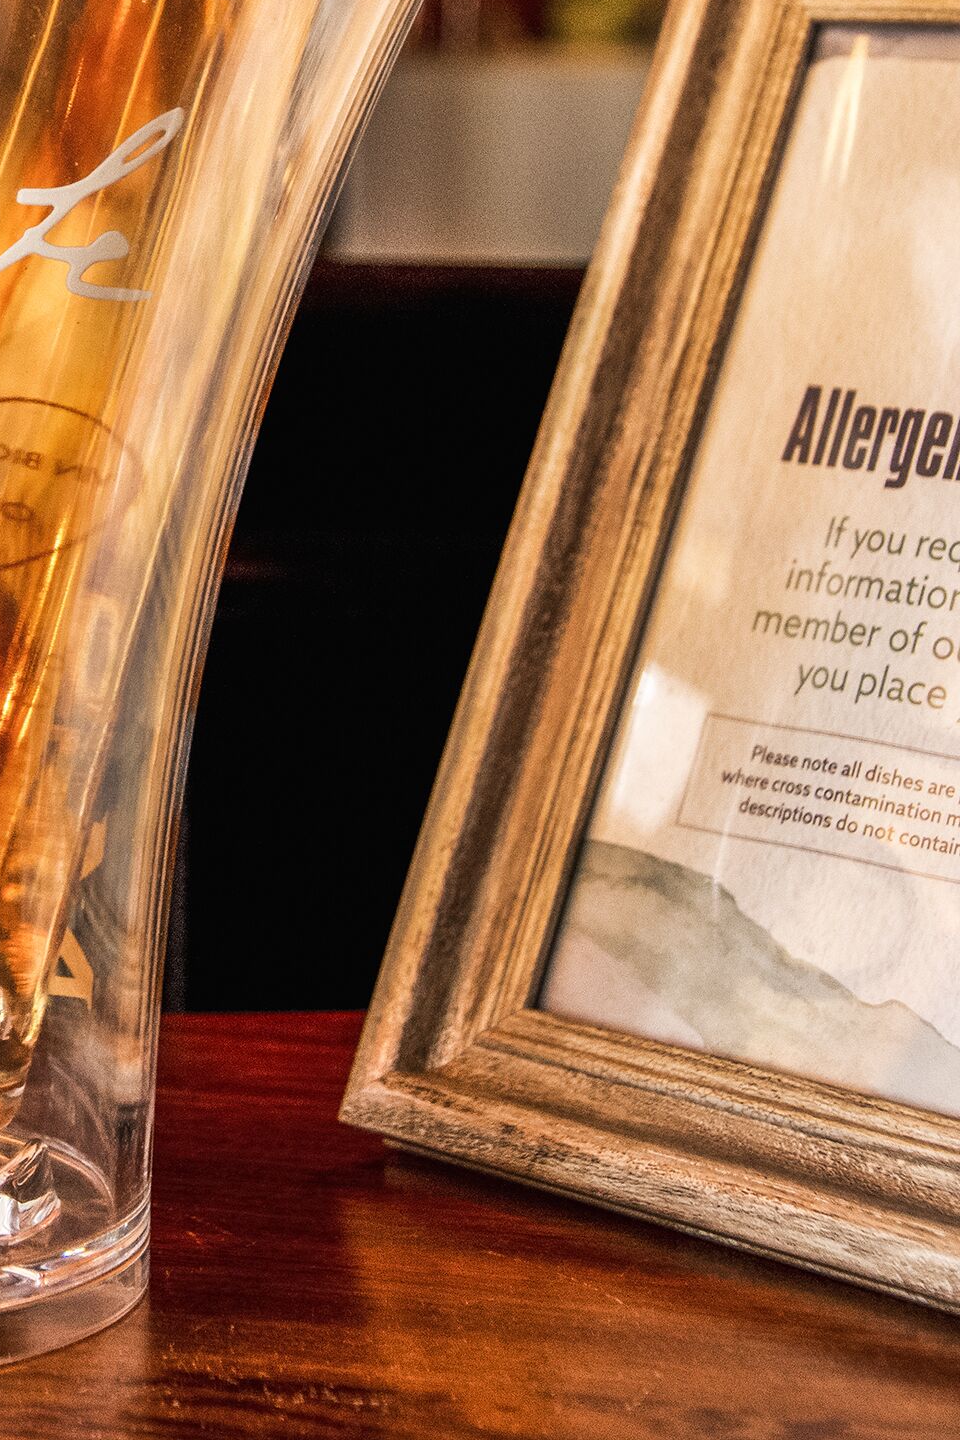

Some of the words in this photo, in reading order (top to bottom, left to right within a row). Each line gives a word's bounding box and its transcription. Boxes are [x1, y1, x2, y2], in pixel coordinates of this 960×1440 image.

[825, 516, 849, 548] If
[851, 528, 906, 559] you
[752, 609, 881, 648] member
[889, 620, 928, 654] of
[794, 663, 848, 696] you
[855, 664, 947, 709] place
[751, 744, 798, 768] Please
[801, 754, 838, 775] note
[841, 760, 863, 779] all
[865, 764, 924, 792] dishes
[928, 781, 955, 798] are
[722, 767, 770, 790] where
[771, 777, 811, 797] cross
[814, 784, 942, 824] contamination
[740, 796, 832, 828] descriptions
[836, 813, 859, 834] do
[863, 823, 896, 842] not
